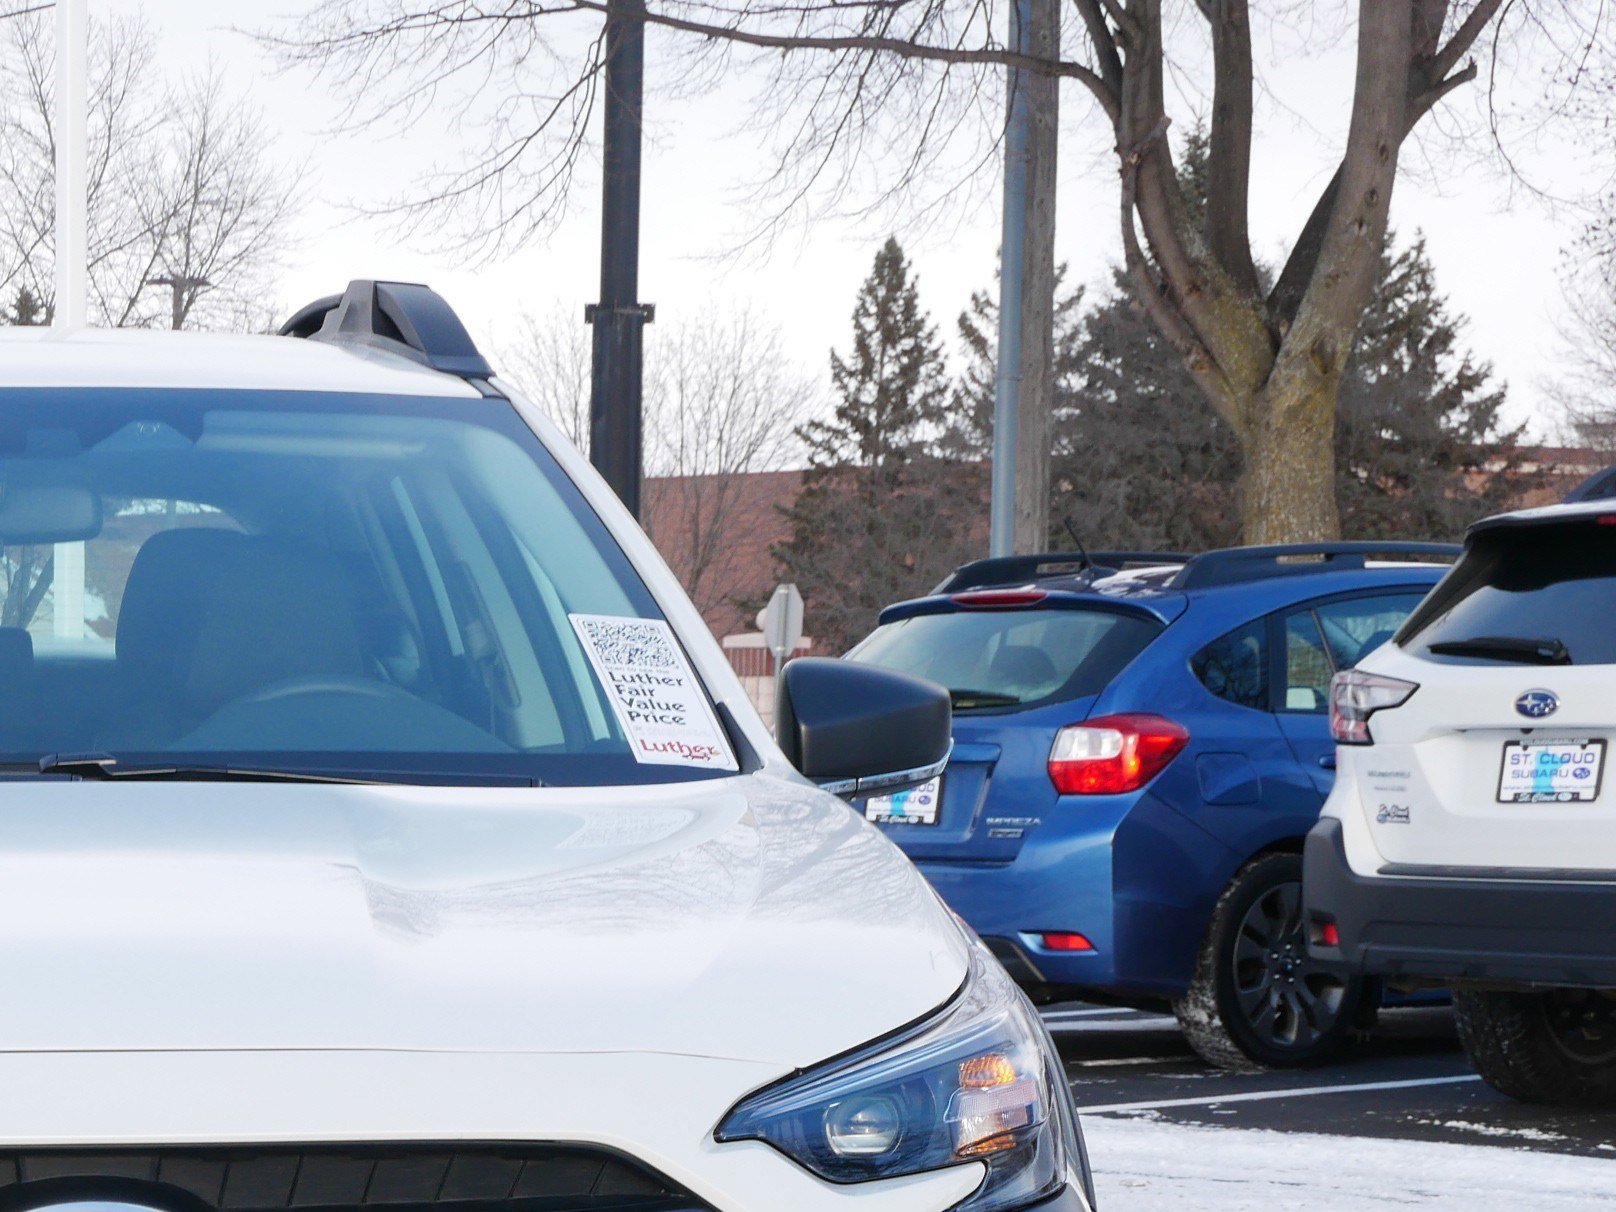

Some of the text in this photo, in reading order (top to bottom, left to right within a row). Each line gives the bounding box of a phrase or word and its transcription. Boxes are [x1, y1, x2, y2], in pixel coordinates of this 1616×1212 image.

[608, 671, 684, 687] Luther
[614, 684, 656, 698] Fair
[619, 697, 687, 713] Value
[627, 710, 687, 726] Price
[639, 738, 717, 756] Luther
[1539, 752, 1596, 765] CLOUD
[1511, 768, 1569, 779] SUBARU
